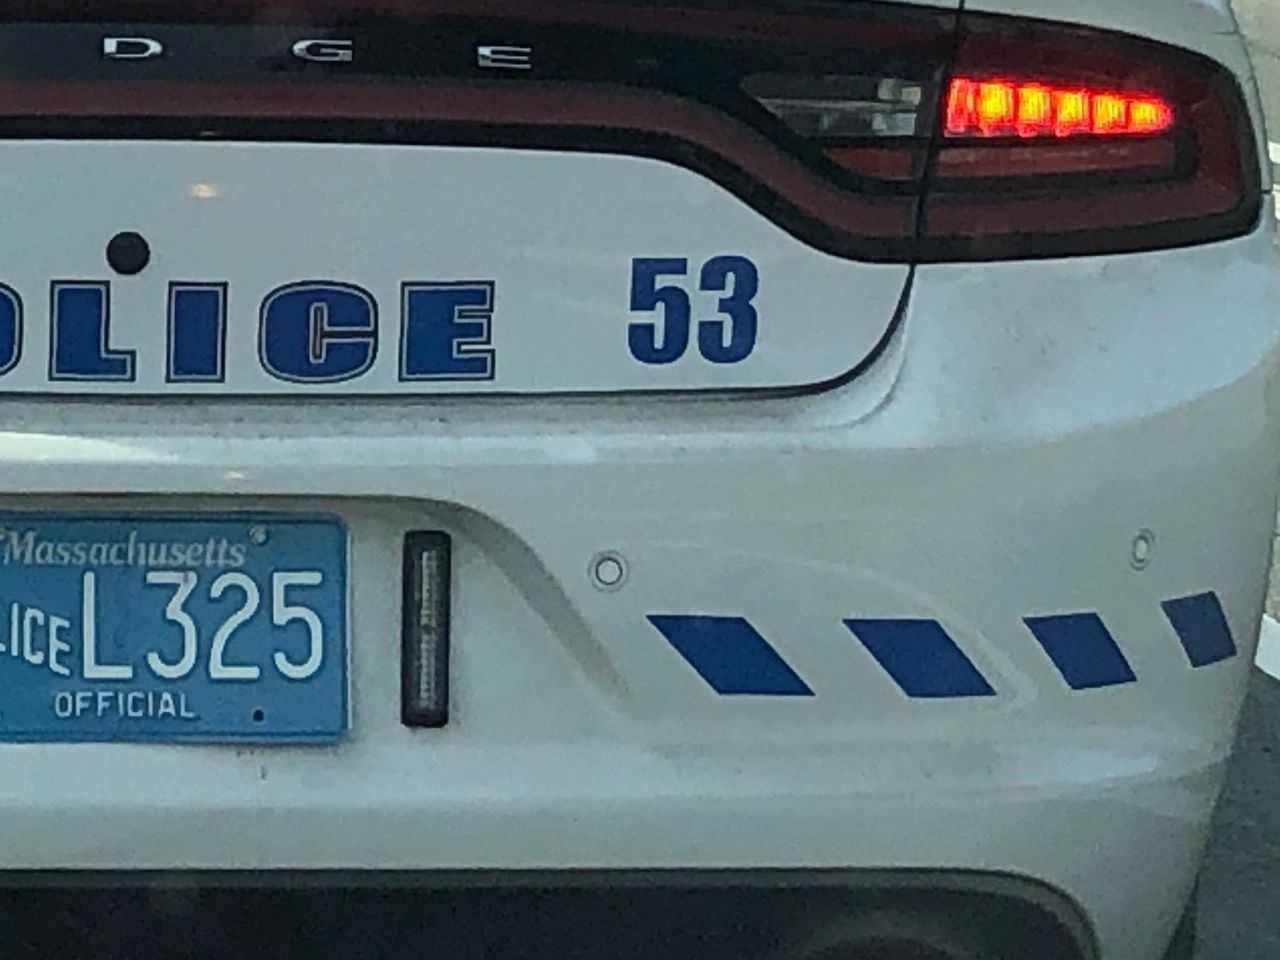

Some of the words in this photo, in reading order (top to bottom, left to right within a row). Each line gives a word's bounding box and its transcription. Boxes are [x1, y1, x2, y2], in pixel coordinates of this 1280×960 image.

[629, 255, 760, 364] 53
[3, 532, 247, 568] Massachusetts
[83, 571, 324, 680] L325
[54, 690, 196, 719] OFFICIAL
